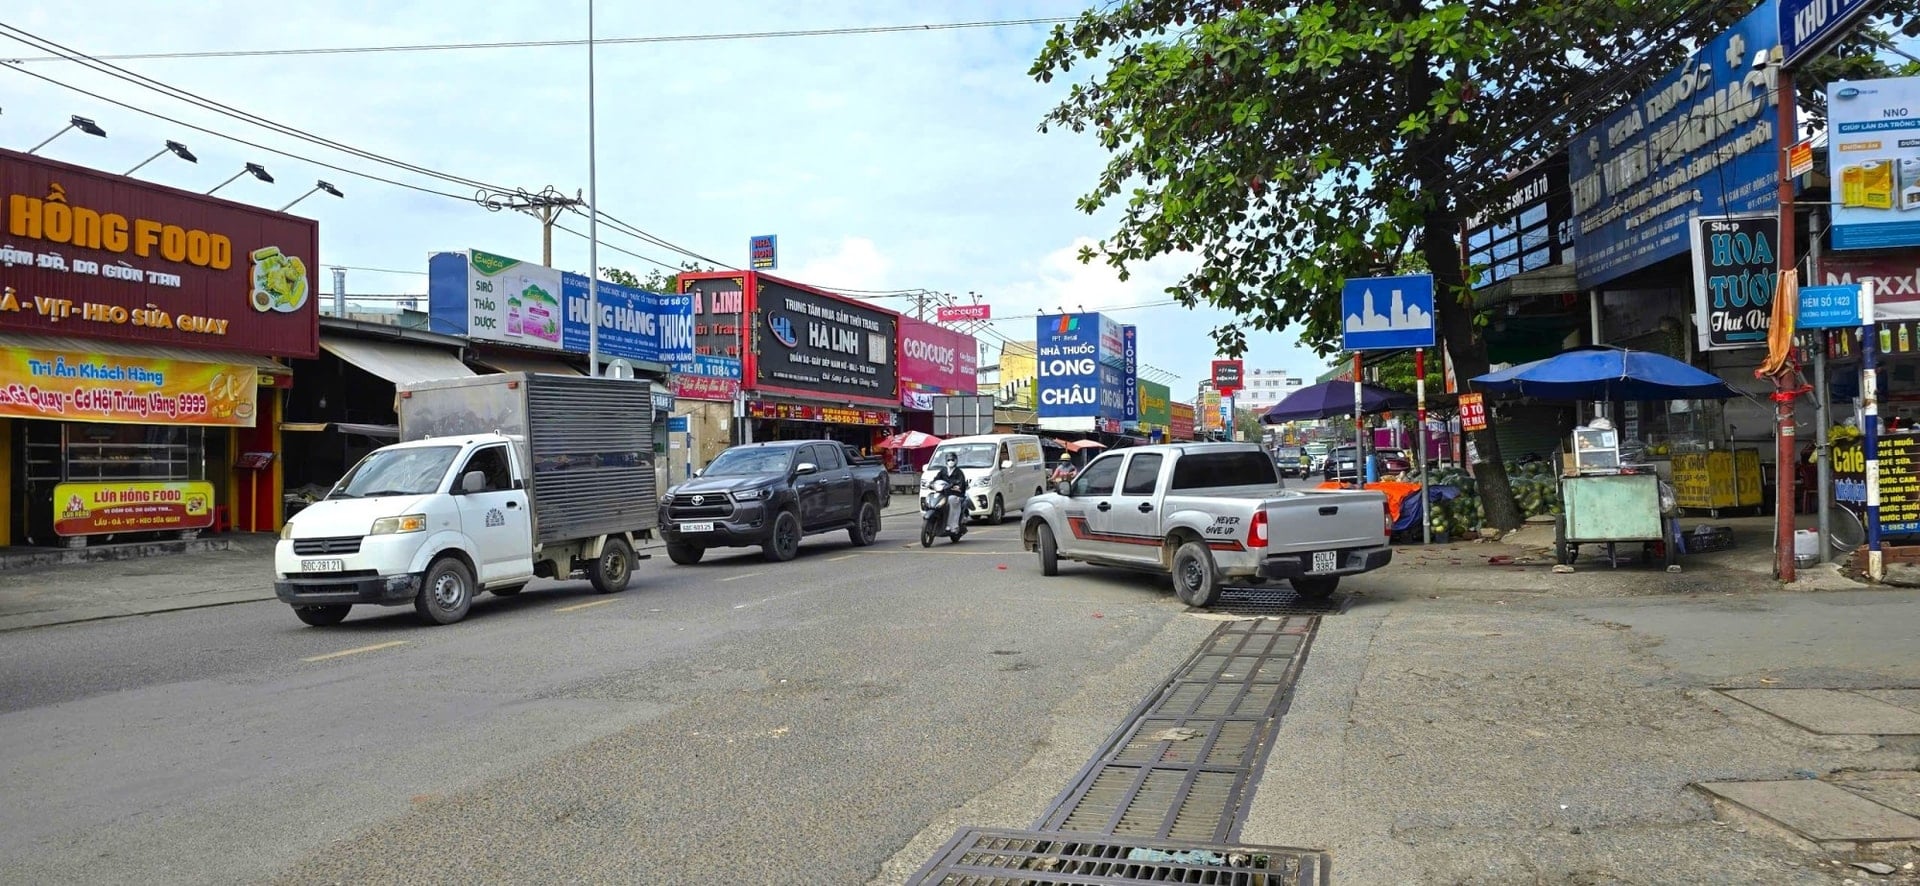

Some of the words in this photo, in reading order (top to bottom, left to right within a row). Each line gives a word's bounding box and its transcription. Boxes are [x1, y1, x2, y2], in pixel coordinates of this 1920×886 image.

[1645, 58, 1712, 123] THUỐC
[1711, 222, 1740, 232] Shop
[135, 218, 232, 271] FOOD
[1711, 231, 1774, 267] HOA
[0, 244, 34, 267] ẬM
[73, 259, 99, 275] DA
[146, 270, 181, 288] TAN
[711, 290, 743, 314] LINH
[1834, 295, 1850, 306] 1423
[34, 296, 73, 322] VỊT
[83, 302, 129, 325] HEO
[176, 313, 230, 336] QUAY
[568, 293, 613, 330] HÙG
[614, 299, 656, 337] HẰNG
[659, 306, 692, 350] THUỐC
[785, 297, 807, 314] TRUNG
[807, 303, 821, 318] TÂM
[821, 307, 835, 321] MUA
[862, 318, 879, 332] TRANG
[808, 320, 830, 350] HÀ
[831, 326, 859, 355] LINH
[1040, 345, 1060, 356] NHÀ
[1062, 342, 1096, 355] THUỐC
[1040, 358, 1096, 377] LONG
[1126, 341, 1134, 374] LONG
[28, 359, 51, 378] Tri
[79, 362, 125, 381] Khách
[127, 366, 164, 386] Hàng
[29, 386, 65, 414] Quay
[92, 387, 113, 417] Hội
[114, 390, 148, 418] Trúng
[149, 392, 177, 418] Vàng
[178, 393, 208, 415] 9999
[1041, 384, 1096, 405] CHÂU
[1878, 440, 1892, 448] AFÉ
[1833, 446, 1865, 473] Café
[152, 489, 181, 501] FOOD
[1206, 527, 1223, 535] GIVE
[1224, 527, 1235, 535] UP
[1214, 516, 1240, 525] NEVER
